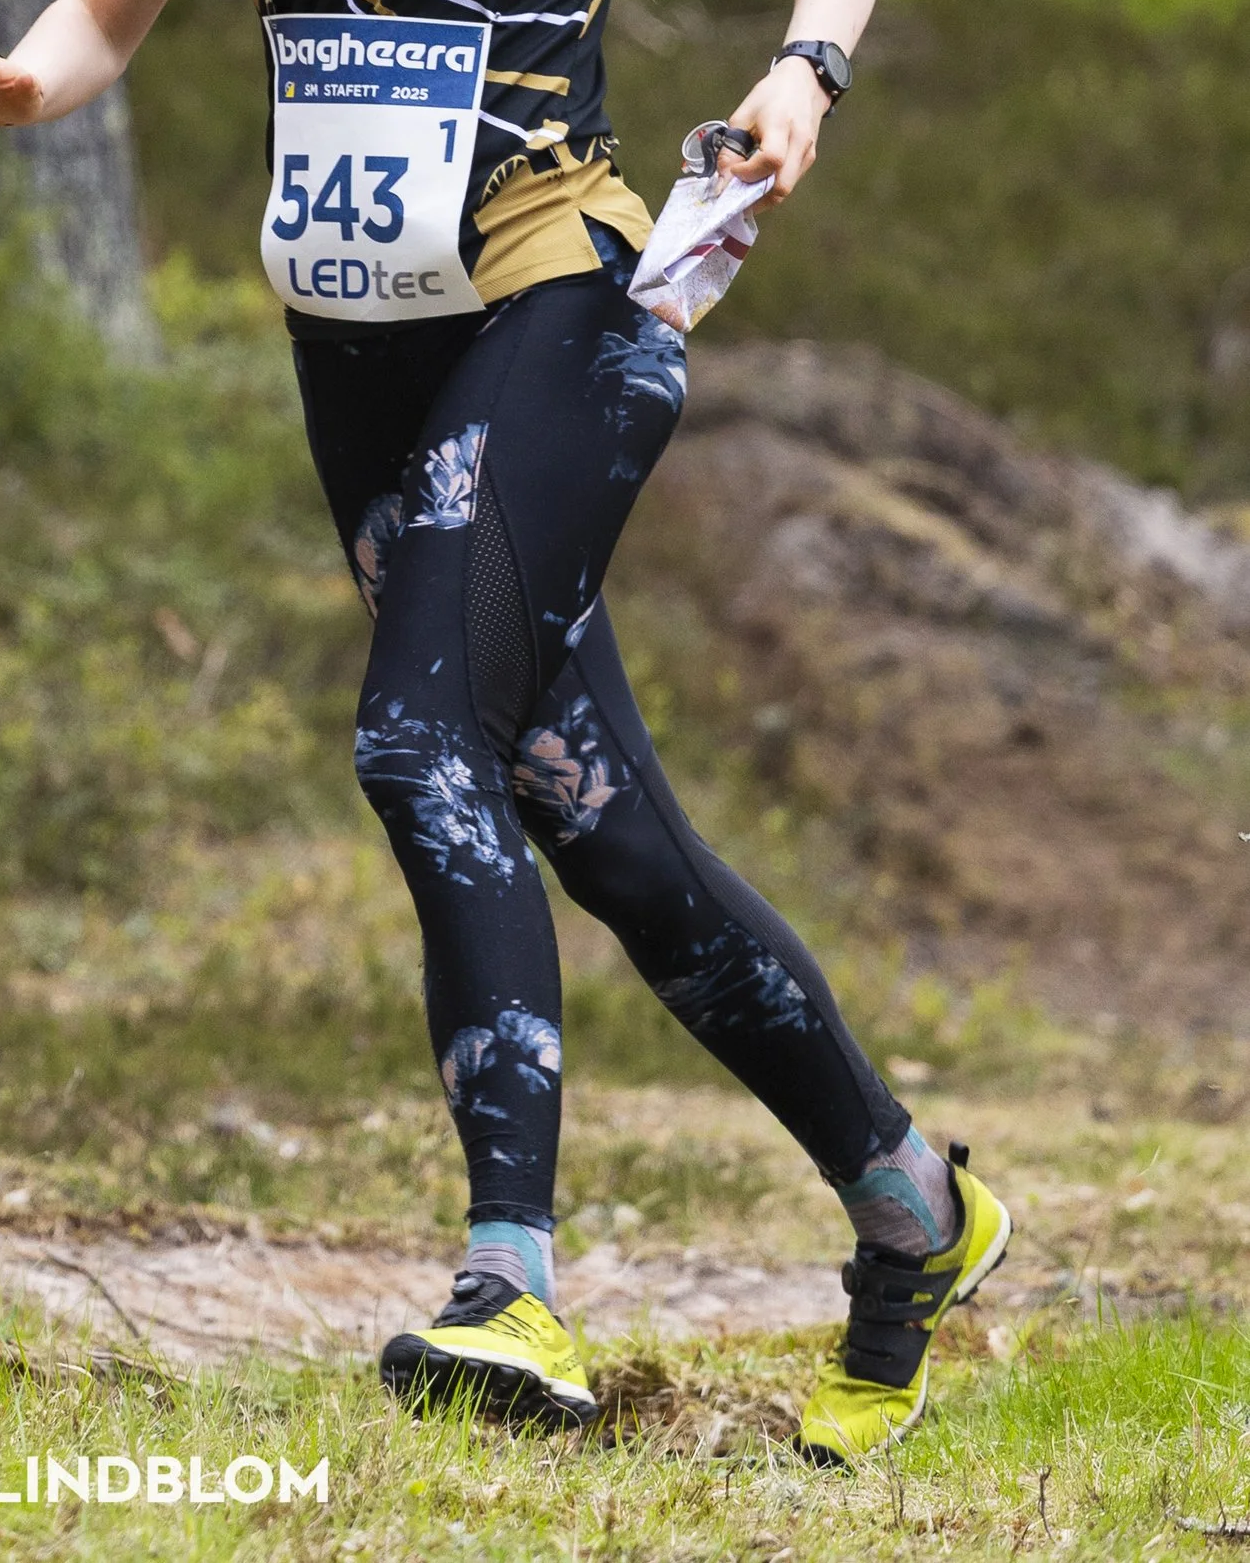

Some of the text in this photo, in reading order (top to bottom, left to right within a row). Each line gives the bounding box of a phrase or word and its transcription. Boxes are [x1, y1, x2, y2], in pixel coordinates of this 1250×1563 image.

[276, 33, 476, 73] bagheera
[303, 83, 429, 101] SM STAFETT 2025
[439, 119, 457, 163] 1
[271, 154, 409, 244] 543
[288, 257, 446, 301] LEDtec
